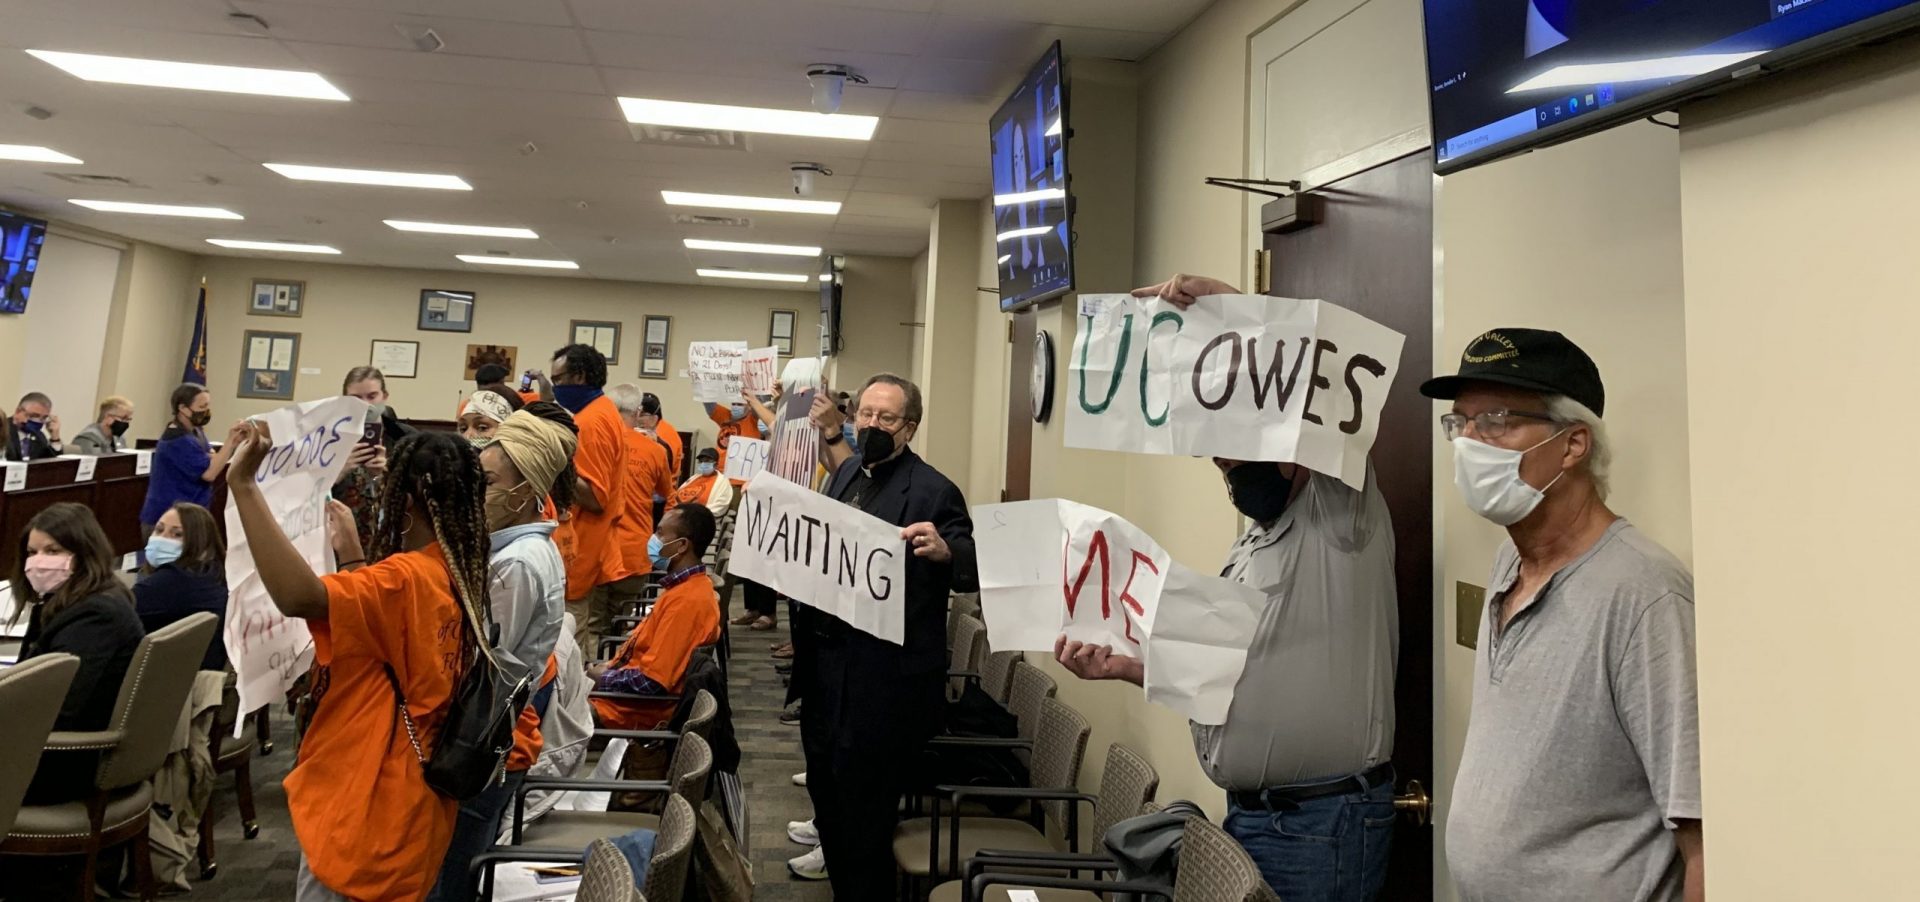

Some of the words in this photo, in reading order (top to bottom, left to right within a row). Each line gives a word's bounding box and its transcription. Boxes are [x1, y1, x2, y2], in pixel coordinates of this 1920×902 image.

[1077, 311, 1184, 427] UC
[1191, 331, 1387, 435] OWES
[1484, 332, 1516, 349] VALLEY
[745, 489, 894, 602] WAITING
